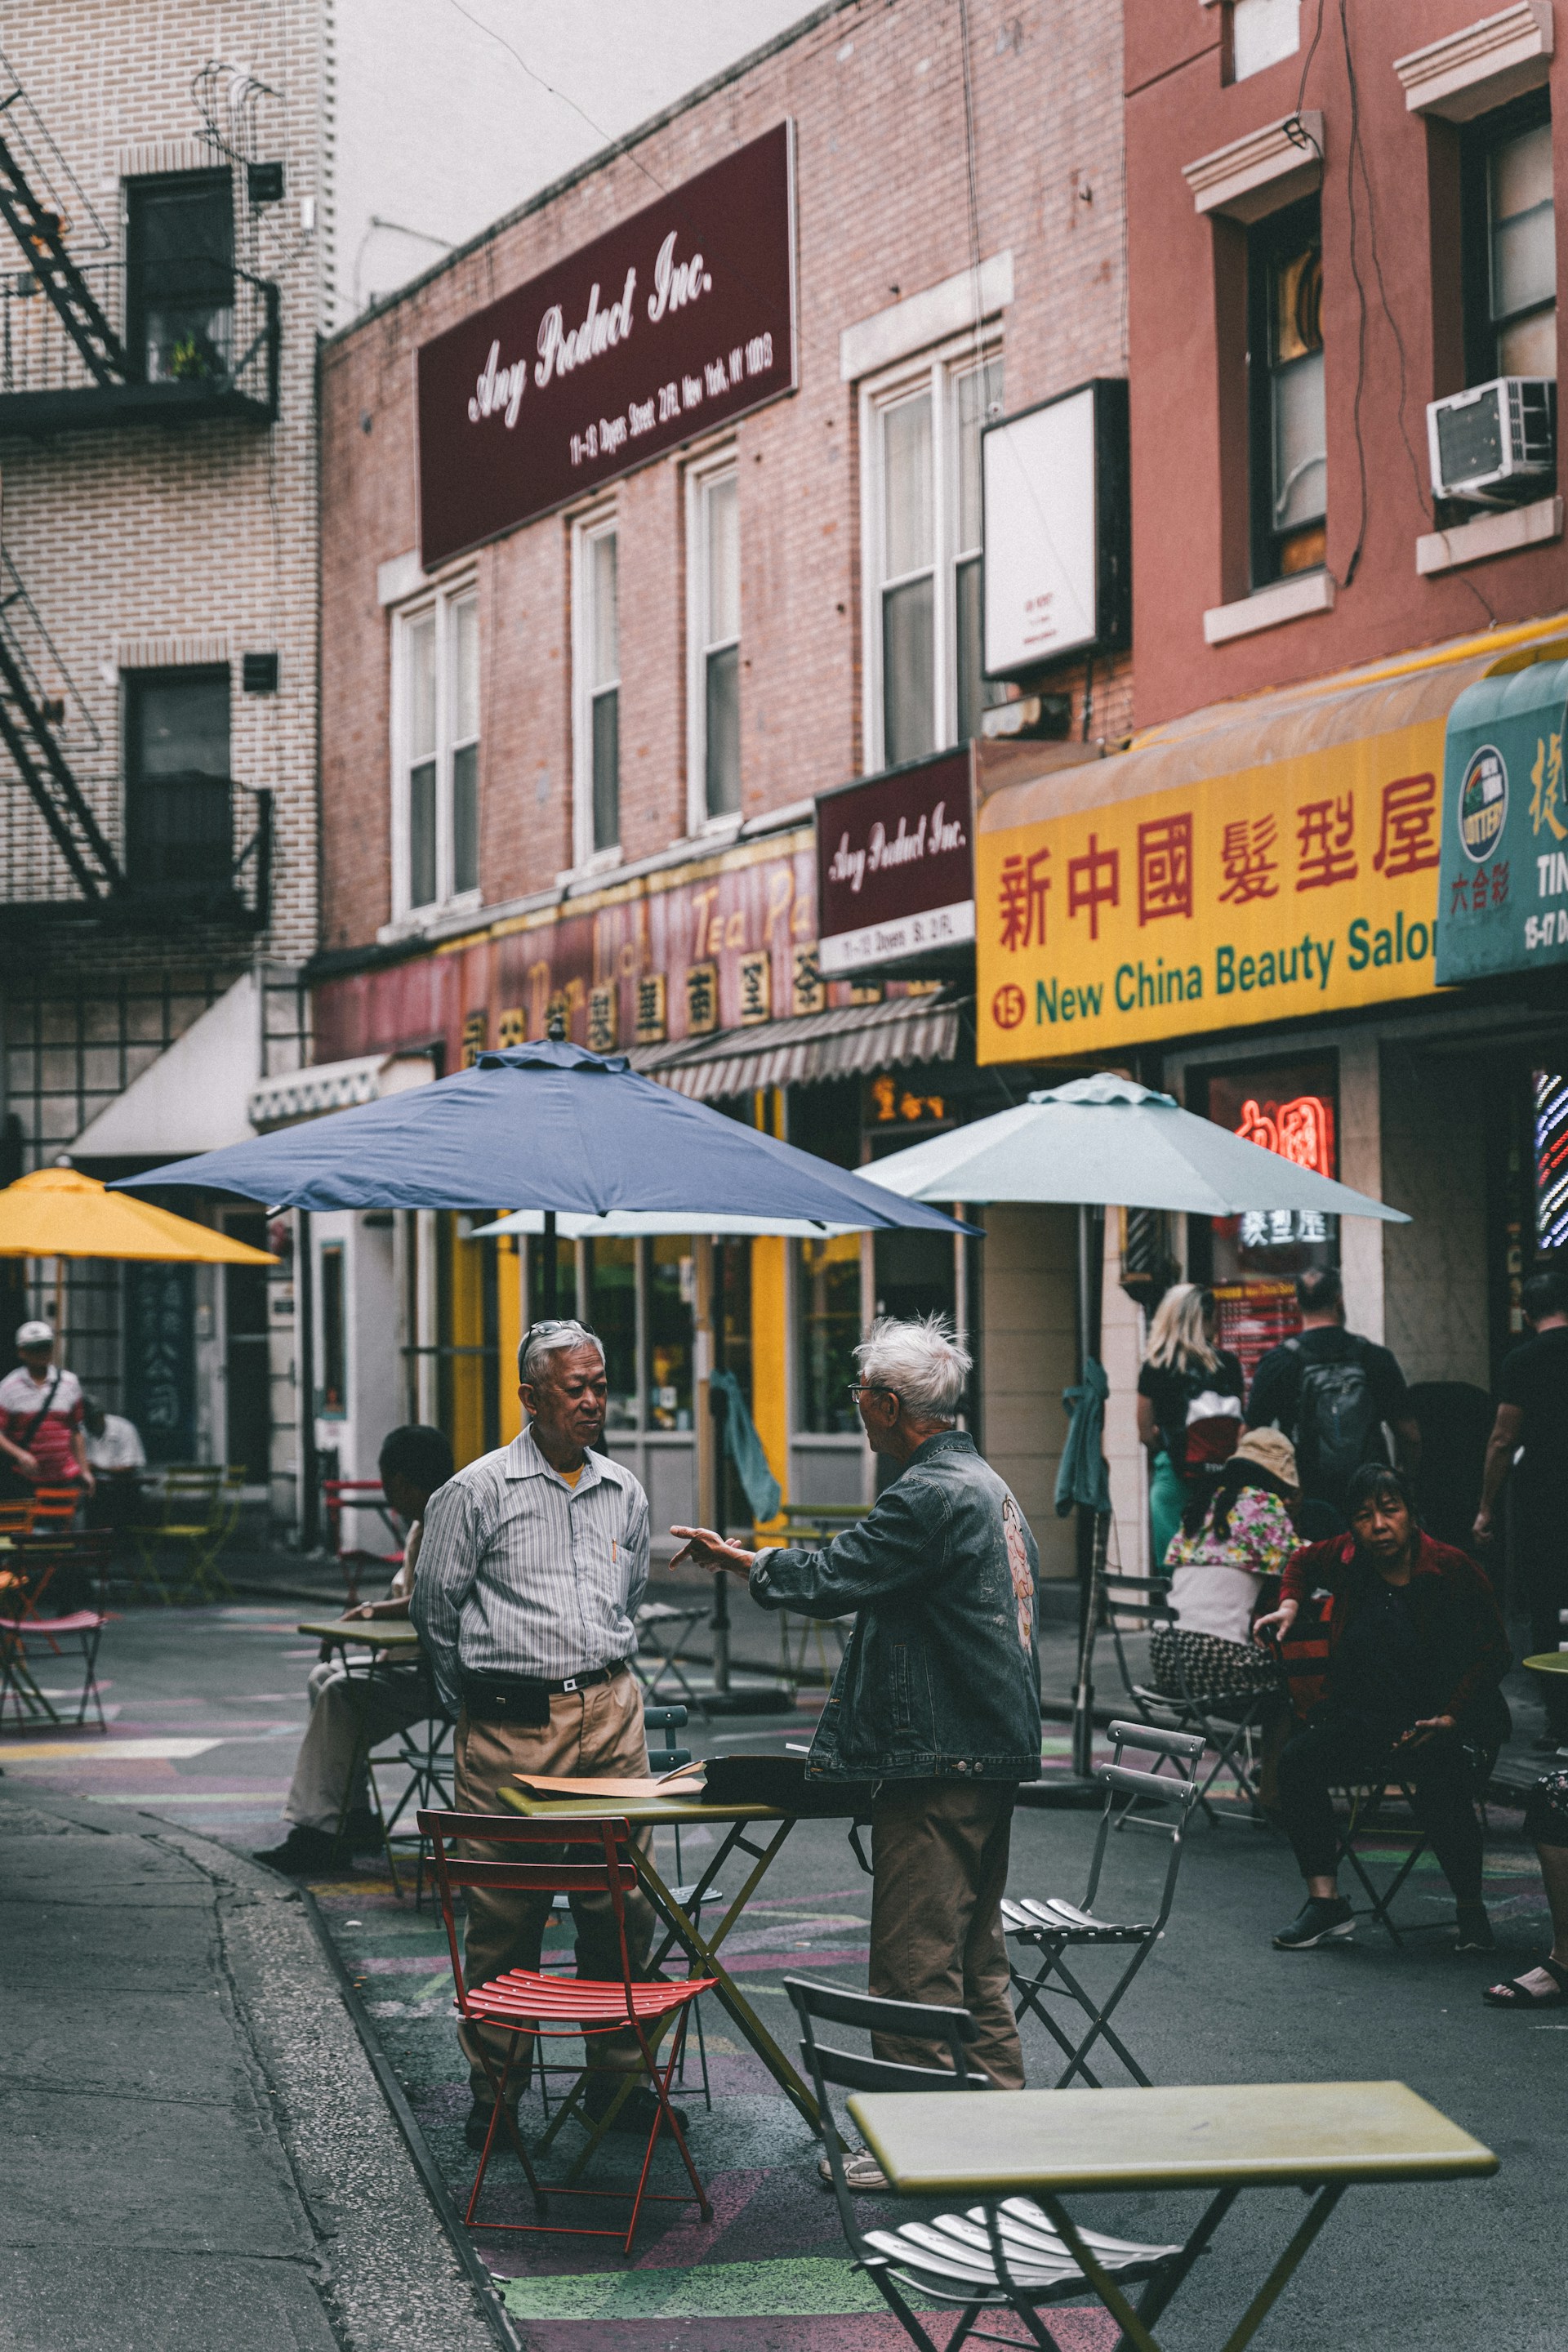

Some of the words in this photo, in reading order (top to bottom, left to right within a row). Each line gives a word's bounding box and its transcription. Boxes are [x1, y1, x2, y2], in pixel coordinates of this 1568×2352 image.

[648, 230, 711, 322] Inc.
[928, 801, 967, 854] Inc.
[1000, 772, 1441, 953] 新中國髮型屋
[1036, 976, 1103, 1026] New
[1116, 957, 1203, 1013] China
[1215, 936, 1334, 994] Beauty
